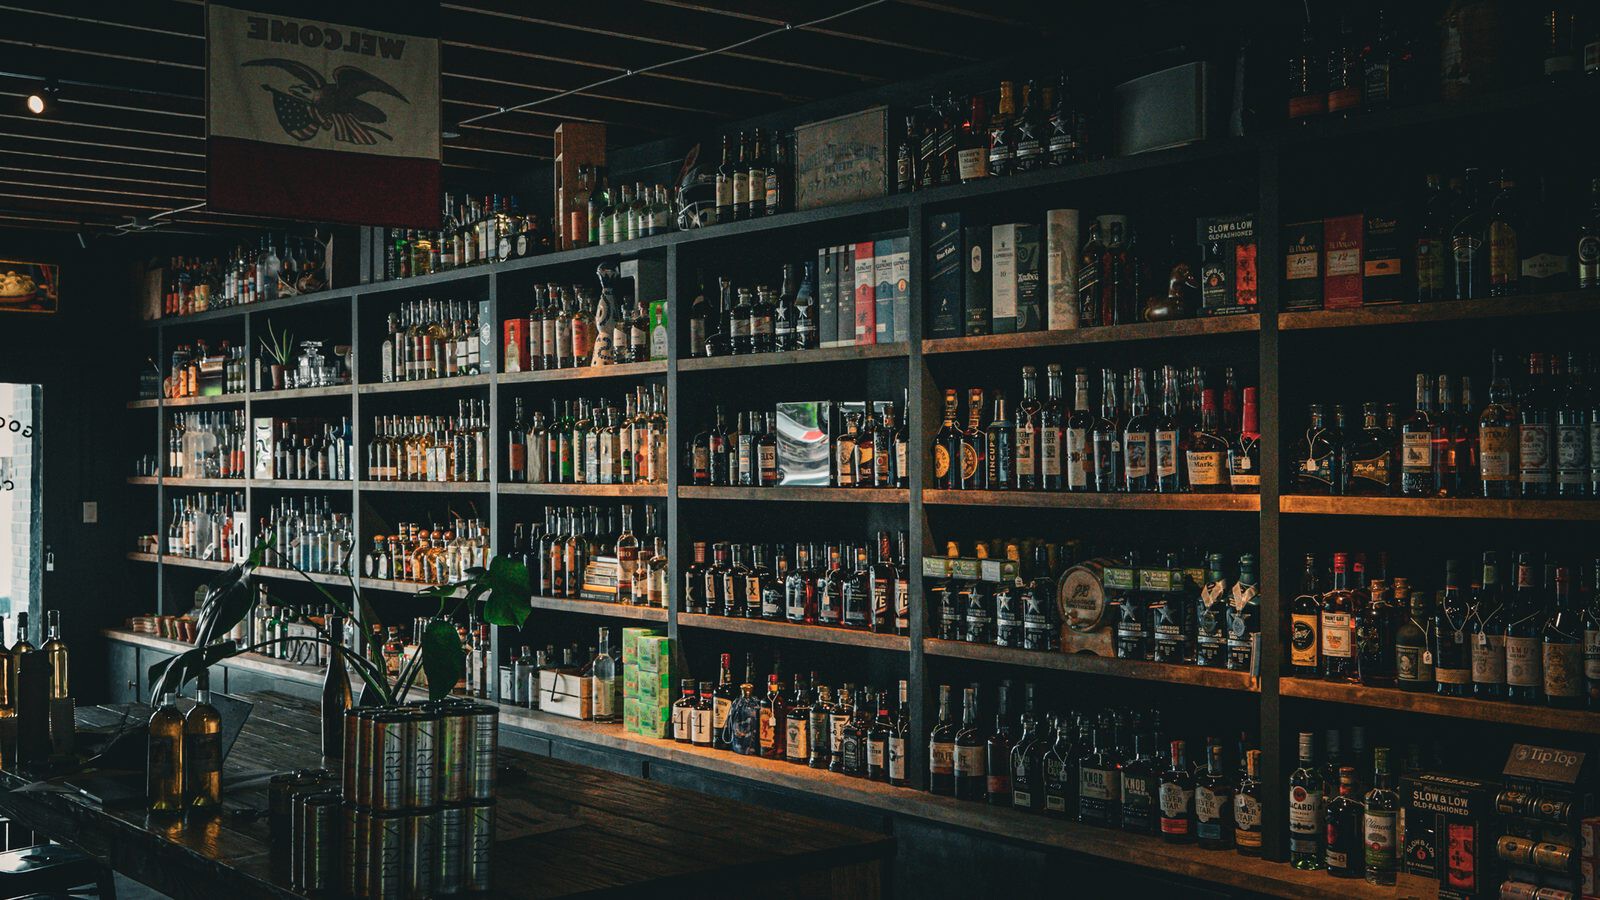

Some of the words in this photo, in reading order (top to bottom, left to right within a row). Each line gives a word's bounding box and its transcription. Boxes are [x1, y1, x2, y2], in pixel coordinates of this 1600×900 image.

[1208, 223, 1229, 234] SLOW
[1229, 222, 1236, 231] &
[1236, 220, 1253, 230] LOW
[1531, 747, 1553, 764] Tip
[1554, 749, 1578, 767] Top
[1083, 768, 1104, 784] KNOB
[1124, 777, 1145, 792] KNOB
[1290, 802, 1316, 812] ACARDI
[1413, 790, 1438, 804] SLOW
[1440, 794, 1447, 804] &
[1448, 795, 1469, 808] LOW
[1413, 800, 1470, 817] OLD-FASHIONED
